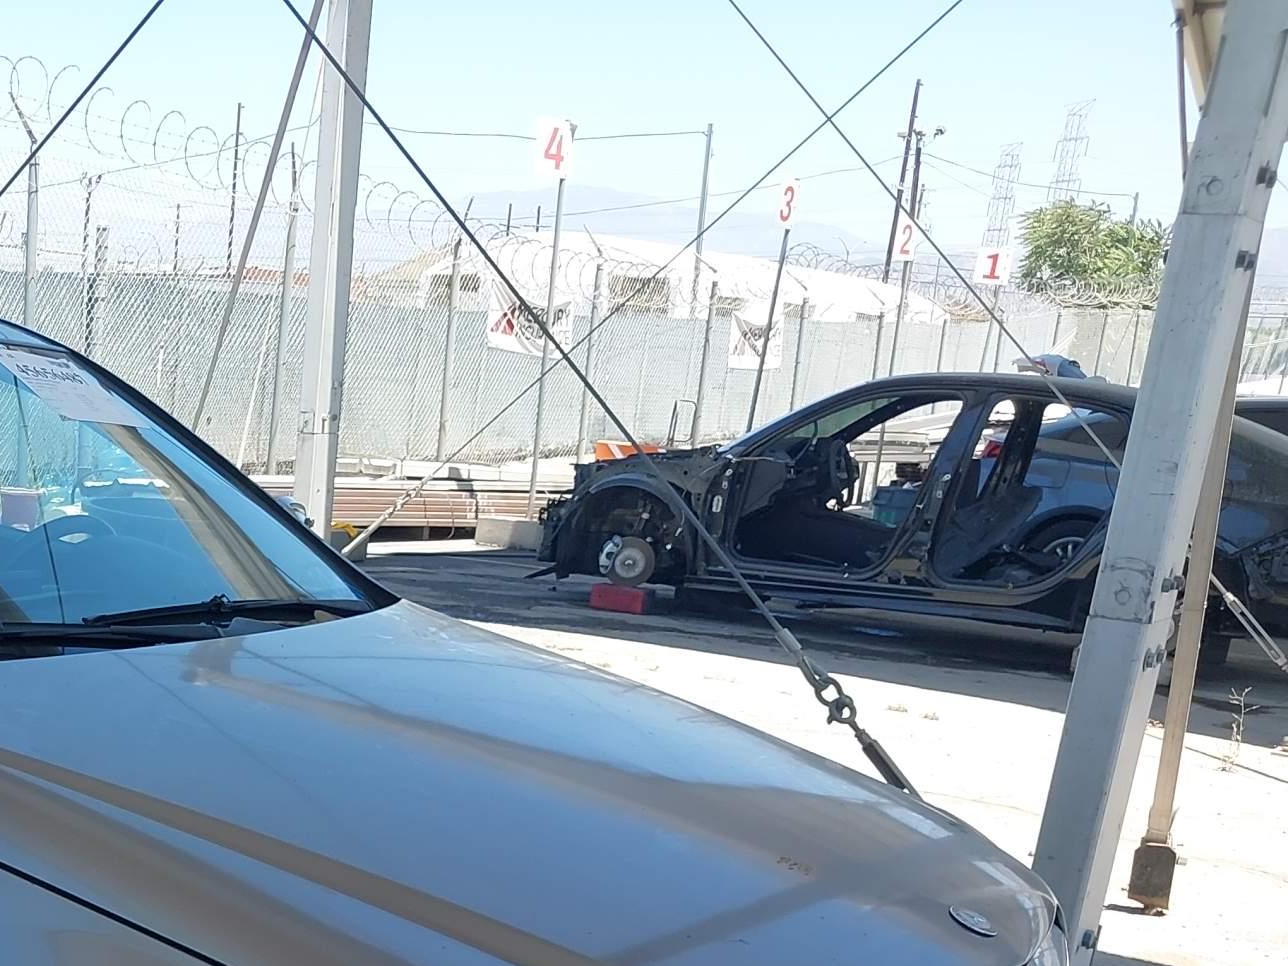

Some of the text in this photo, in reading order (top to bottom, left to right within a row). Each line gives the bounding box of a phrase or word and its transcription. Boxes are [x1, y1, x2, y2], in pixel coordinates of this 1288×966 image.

[544, 127, 564, 170] 4
[780, 186, 794, 222] 3
[899, 224, 912, 255] 2
[982, 253, 1000, 279] 1
